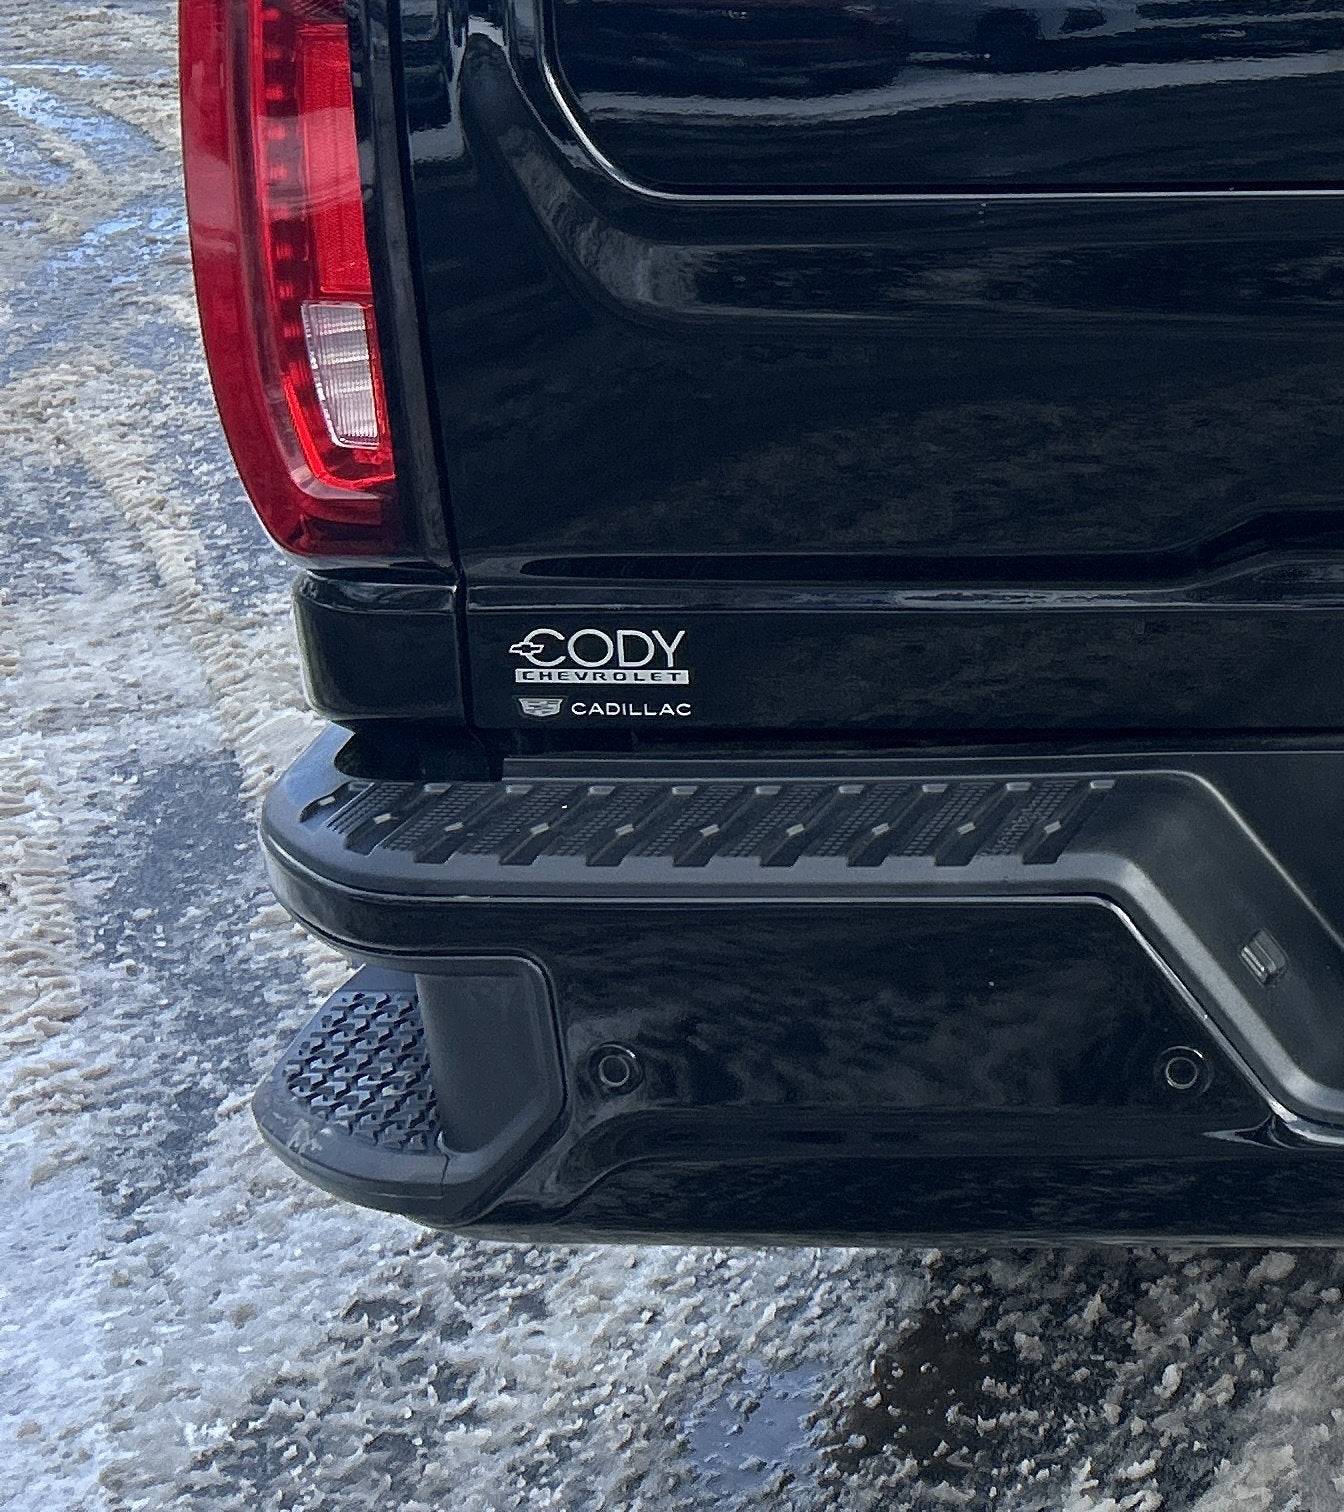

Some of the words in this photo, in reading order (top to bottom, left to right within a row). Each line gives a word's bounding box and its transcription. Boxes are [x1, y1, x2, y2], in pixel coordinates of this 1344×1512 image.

[510, 628, 686, 668] CODY
[520, 670, 683, 682] CHEVROLET
[571, 702, 692, 716] CADILLAC
